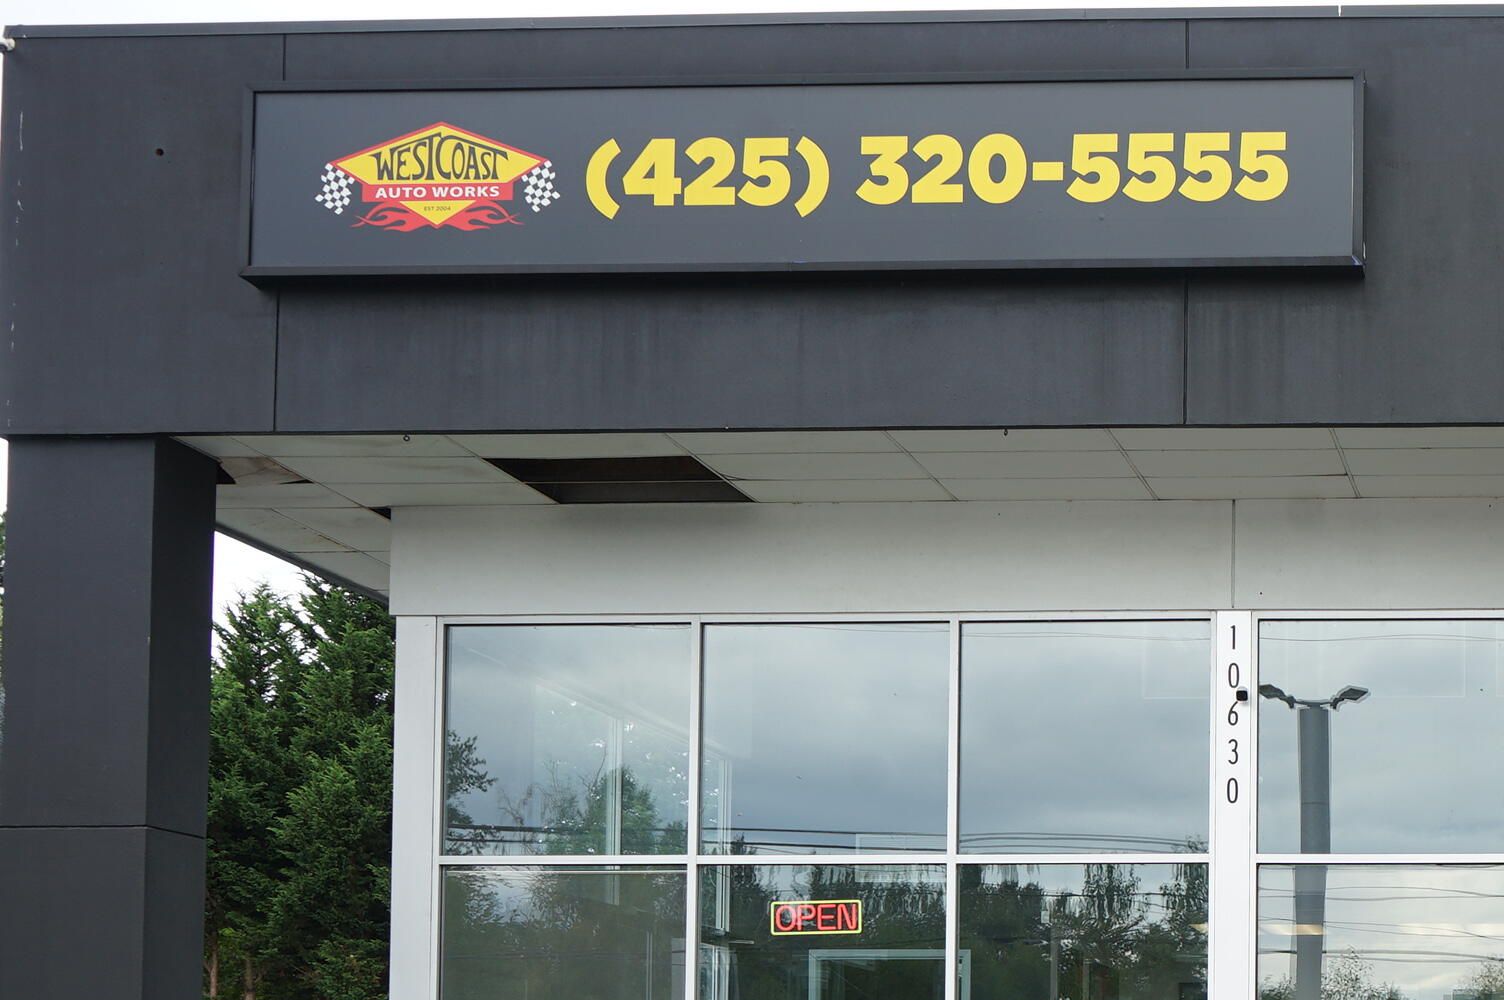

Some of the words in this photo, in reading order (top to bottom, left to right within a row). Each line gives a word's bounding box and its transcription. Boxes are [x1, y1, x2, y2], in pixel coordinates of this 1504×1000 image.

[585, 136, 830, 220] (425)
[855, 131, 1289, 205] 320-5555
[375, 186, 427, 199] AUTO
[431, 185, 501, 198] WORKS
[775, 903, 858, 931] OPEN
